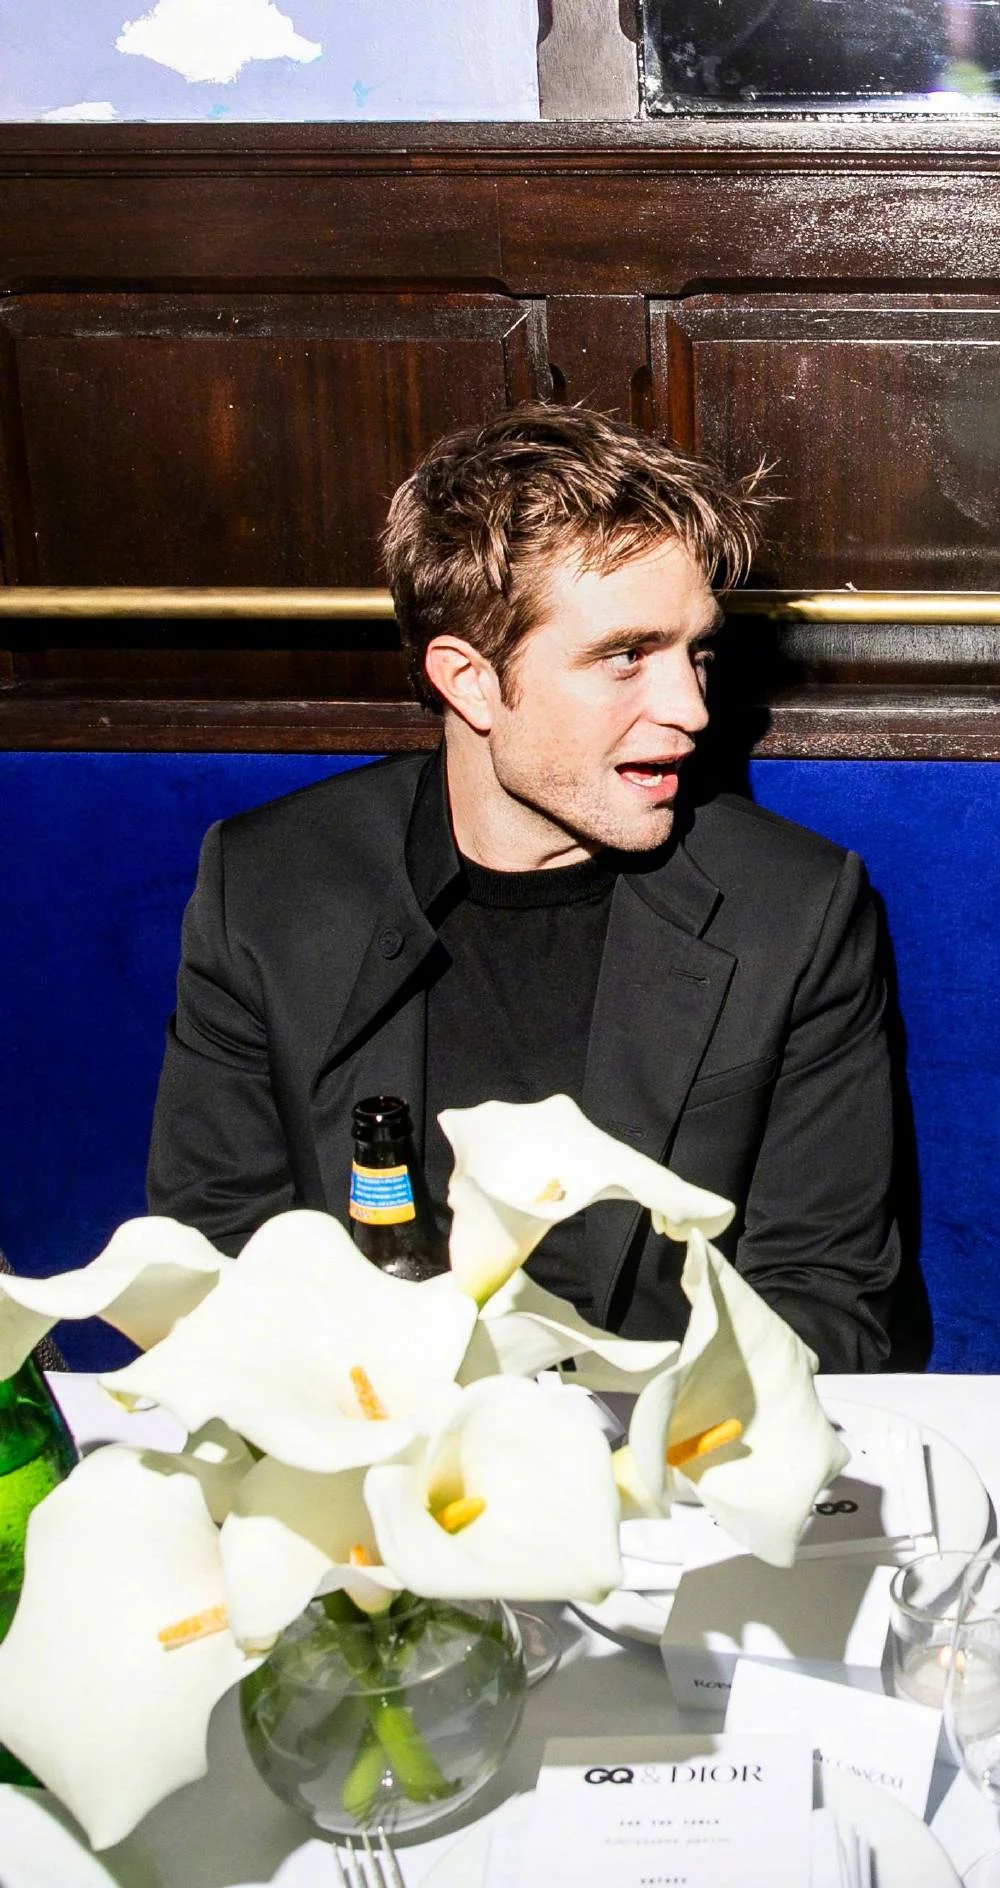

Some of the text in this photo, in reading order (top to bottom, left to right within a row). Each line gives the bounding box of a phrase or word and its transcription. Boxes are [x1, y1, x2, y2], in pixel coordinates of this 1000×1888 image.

[584, 1765, 763, 1785] GQ & DIOR
